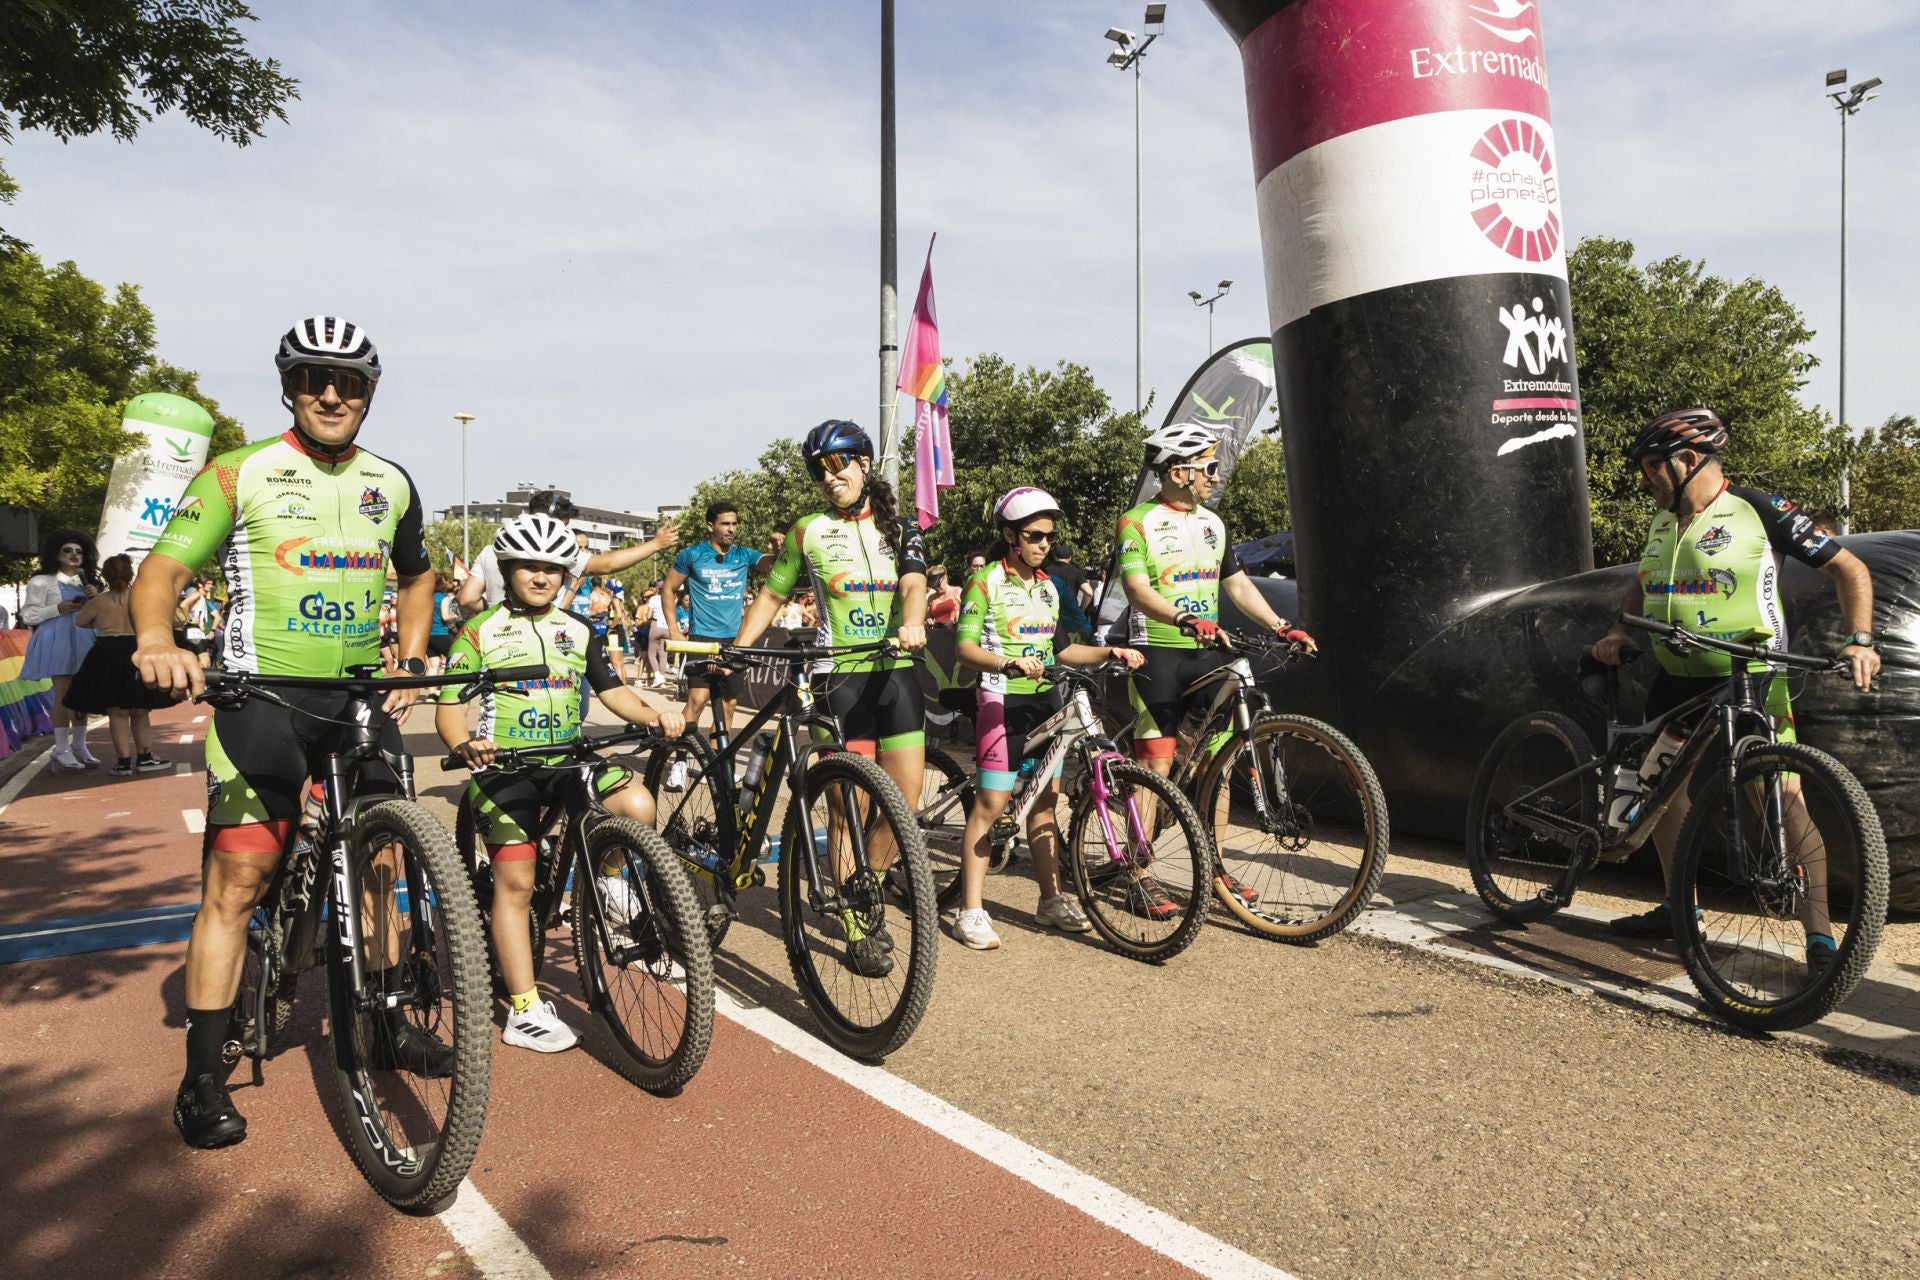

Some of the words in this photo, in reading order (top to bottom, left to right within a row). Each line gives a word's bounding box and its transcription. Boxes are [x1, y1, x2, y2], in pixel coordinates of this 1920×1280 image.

[1410, 45, 1548, 90] Extremadu
[1472, 169, 1542, 189] #nohay
[1471, 184, 1546, 203] planeta
[1503, 379, 1571, 393] Extremadura
[1491, 412, 1533, 426] Deporte
[1535, 410, 1559, 422] desde
[1560, 410, 1566, 421] la
[266, 477, 312, 485] ROMAUTO
[308, 550, 335, 570] LA
[299, 591, 355, 621] Gas
[1174, 595, 1208, 613] Gas
[849, 607, 885, 627] Gas
[493, 630, 522, 638] ROMAUTO
[519, 706, 561, 729] Gas
